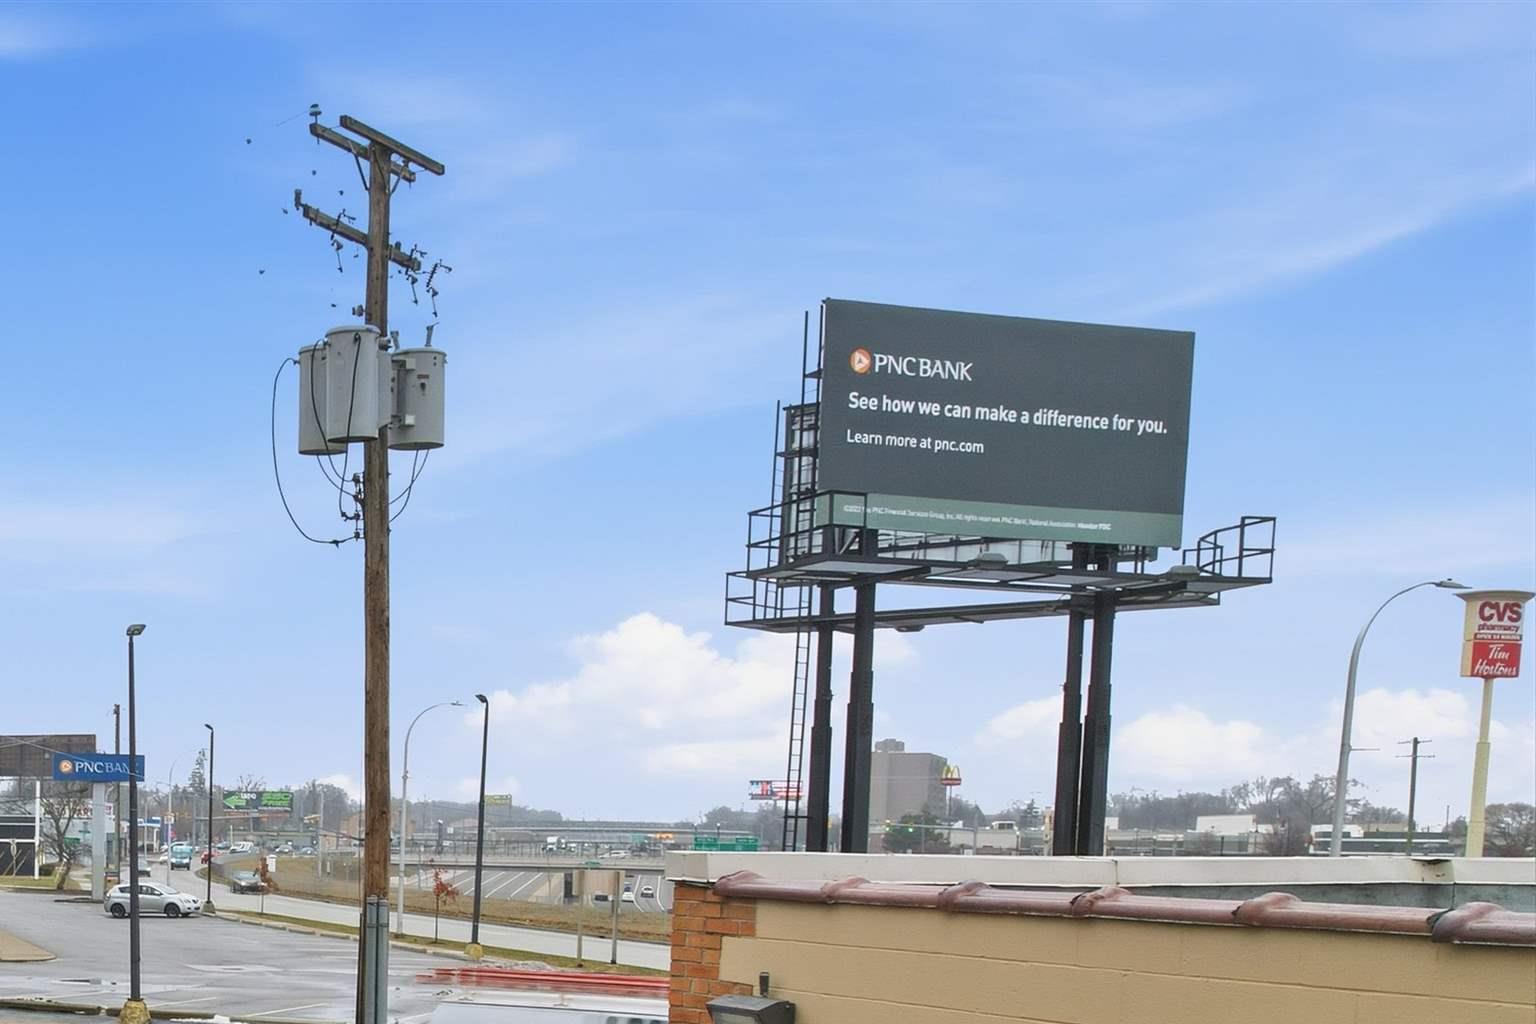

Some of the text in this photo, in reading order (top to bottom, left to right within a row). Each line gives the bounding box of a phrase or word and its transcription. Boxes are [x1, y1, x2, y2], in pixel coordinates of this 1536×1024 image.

[848, 391, 1168, 436] See how we can make a difference for you.
[847, 429, 985, 454] Learn more at pnc.com
[1478, 600, 1522, 623] CVS
[1489, 643, 1510, 660] Tim
